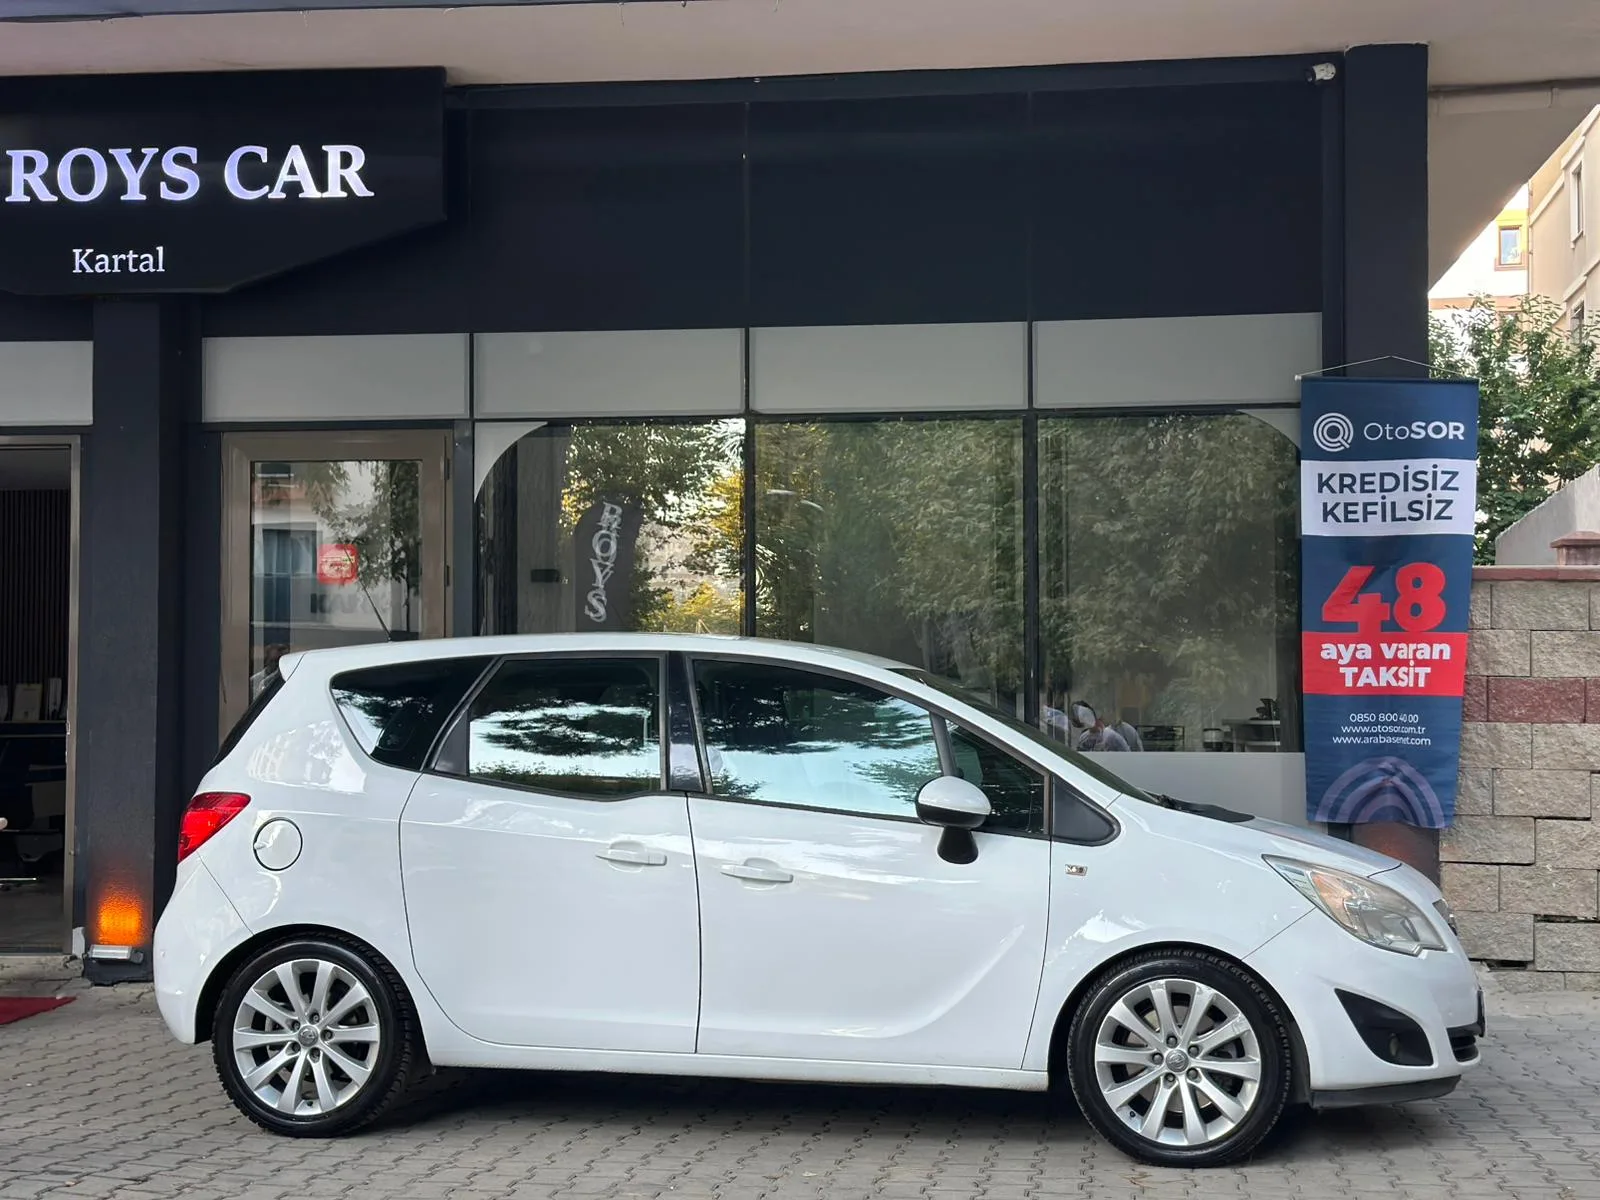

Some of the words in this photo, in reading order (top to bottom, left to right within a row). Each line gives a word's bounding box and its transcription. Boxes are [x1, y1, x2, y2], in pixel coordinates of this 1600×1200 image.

[5, 147, 200, 202] ROYS
[224, 144, 375, 200] CAR
[72, 246, 165, 273] Kartal
[1363, 421, 1465, 441] OtoSOR
[1317, 464, 1460, 494] KREDİSİZ
[1322, 493, 1454, 523] KEFİLSİZ
[585, 501, 623, 622] ROYS
[1321, 562, 1447, 634] 48
[1320, 643, 1372, 665] aya
[1380, 642, 1451, 660] varan
[1339, 660, 1431, 688] TAKSİT
[1349, 713, 1376, 723] 0850
